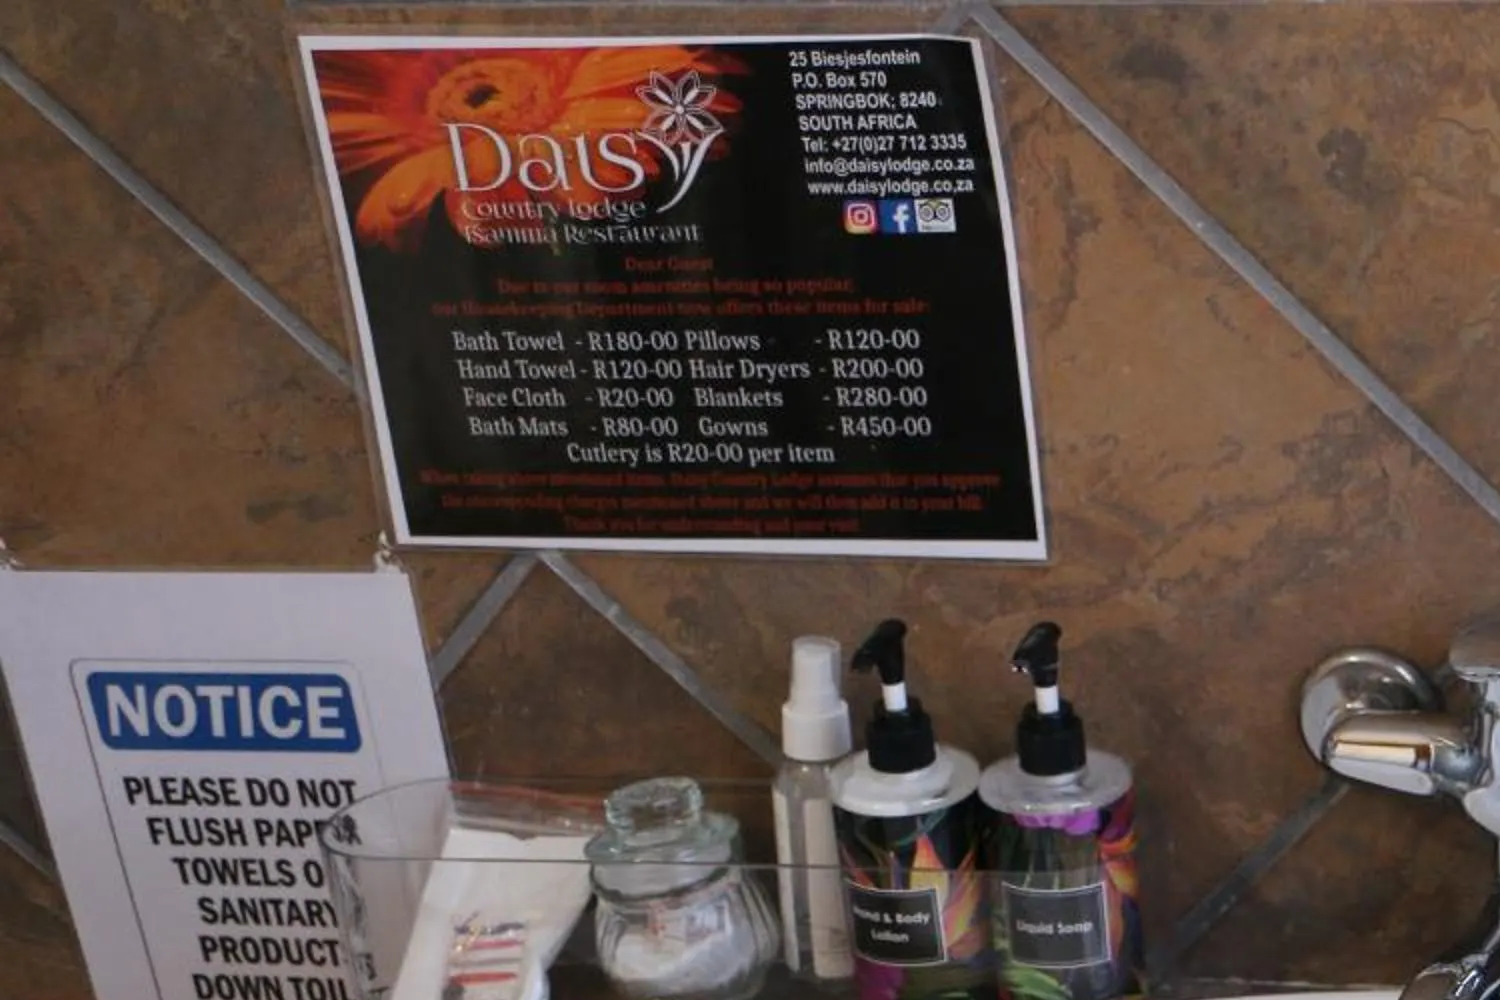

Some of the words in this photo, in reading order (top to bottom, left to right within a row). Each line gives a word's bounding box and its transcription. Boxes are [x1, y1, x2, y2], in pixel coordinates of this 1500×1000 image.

[790, 51, 807, 67] 25
[811, 50, 921, 69] Biesjesfontein
[791, 73, 822, 88] P.O.
[826, 73, 856, 88] Box
[860, 72, 887, 87] 570
[900, 91, 936, 108] 8240
[799, 115, 853, 131] SOUTH
[857, 114, 917, 130] AFRICA
[802, 136, 828, 152] Tel:
[832, 135, 894, 154] +27(0)27
[900, 135, 927, 151] 712
[931, 133, 967, 150] 3335
[441, 122, 724, 214] Daisy
[804, 156, 976, 177] info@daisylodge.co.za
[452, 330, 499, 351] Bath
[502, 330, 565, 351] Towel
[588, 330, 679, 351] R180-00
[685, 329, 761, 350] Pillows
[828, 328, 921, 349] R120-00
[457, 359, 511, 380] Hand
[514, 359, 576, 380] Towel
[592, 359, 683, 380] R120-00
[688, 358, 734, 379] Hair
[739, 358, 811, 383] Dryers
[832, 357, 924, 378] R200-00
[462, 387, 508, 407] Face
[511, 387, 566, 407] Cloth
[598, 387, 674, 407] R20-00
[694, 386, 785, 407] Blankets
[835, 386, 928, 407] R280-00
[469, 416, 516, 437] Bath
[518, 416, 570, 437] Mats
[603, 416, 679, 437] R80-00
[699, 416, 769, 437] Gowns
[840, 416, 932, 437] R450-00
[567, 442, 640, 467] Cutlery
[646, 442, 662, 463] is
[668, 443, 743, 463] R20-00
[748, 446, 784, 468] per
[788, 443, 836, 462] item
[105, 683, 347, 740] NOTICE
[123, 776, 241, 807] PLEASE
[245, 777, 289, 807] DO
[296, 779, 357, 809] NOT
[146, 817, 248, 846] FLUSH
[171, 857, 297, 887] TOWELS
[303, 860, 325, 888] O
